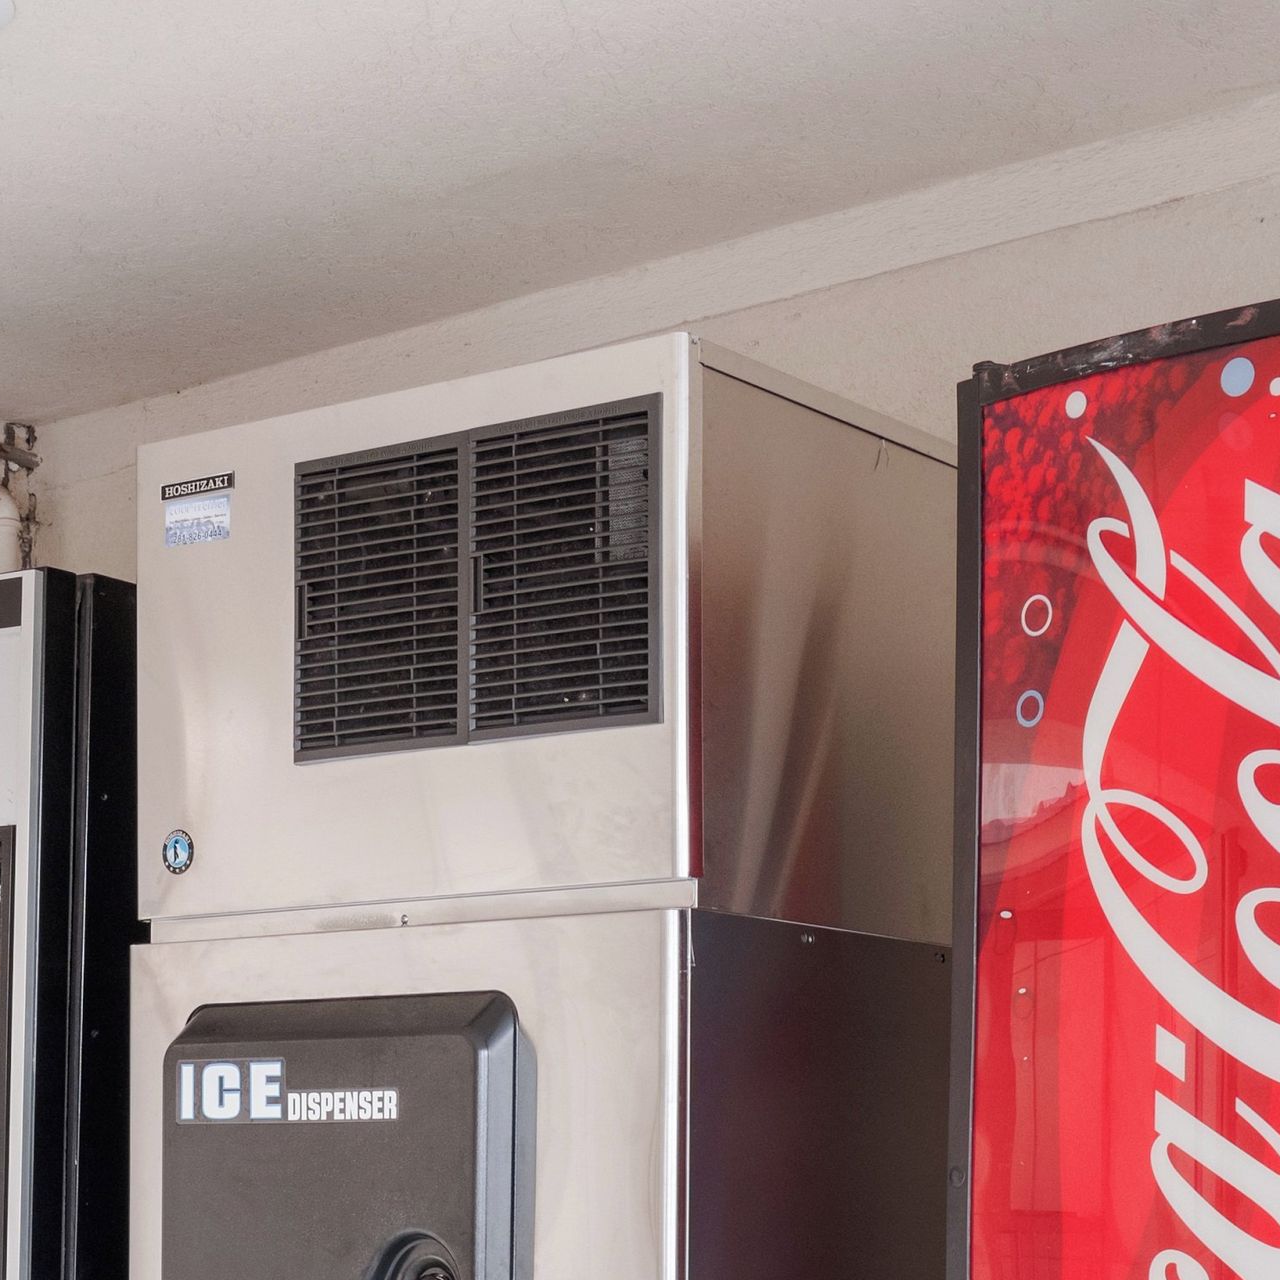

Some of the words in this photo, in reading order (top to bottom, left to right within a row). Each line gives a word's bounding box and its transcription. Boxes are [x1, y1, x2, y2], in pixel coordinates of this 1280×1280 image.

[165, 476, 228, 498] HOSHIZAKI
[180, 1060, 283, 1121] ICE
[287, 1090, 398, 1122] DISPENSER
